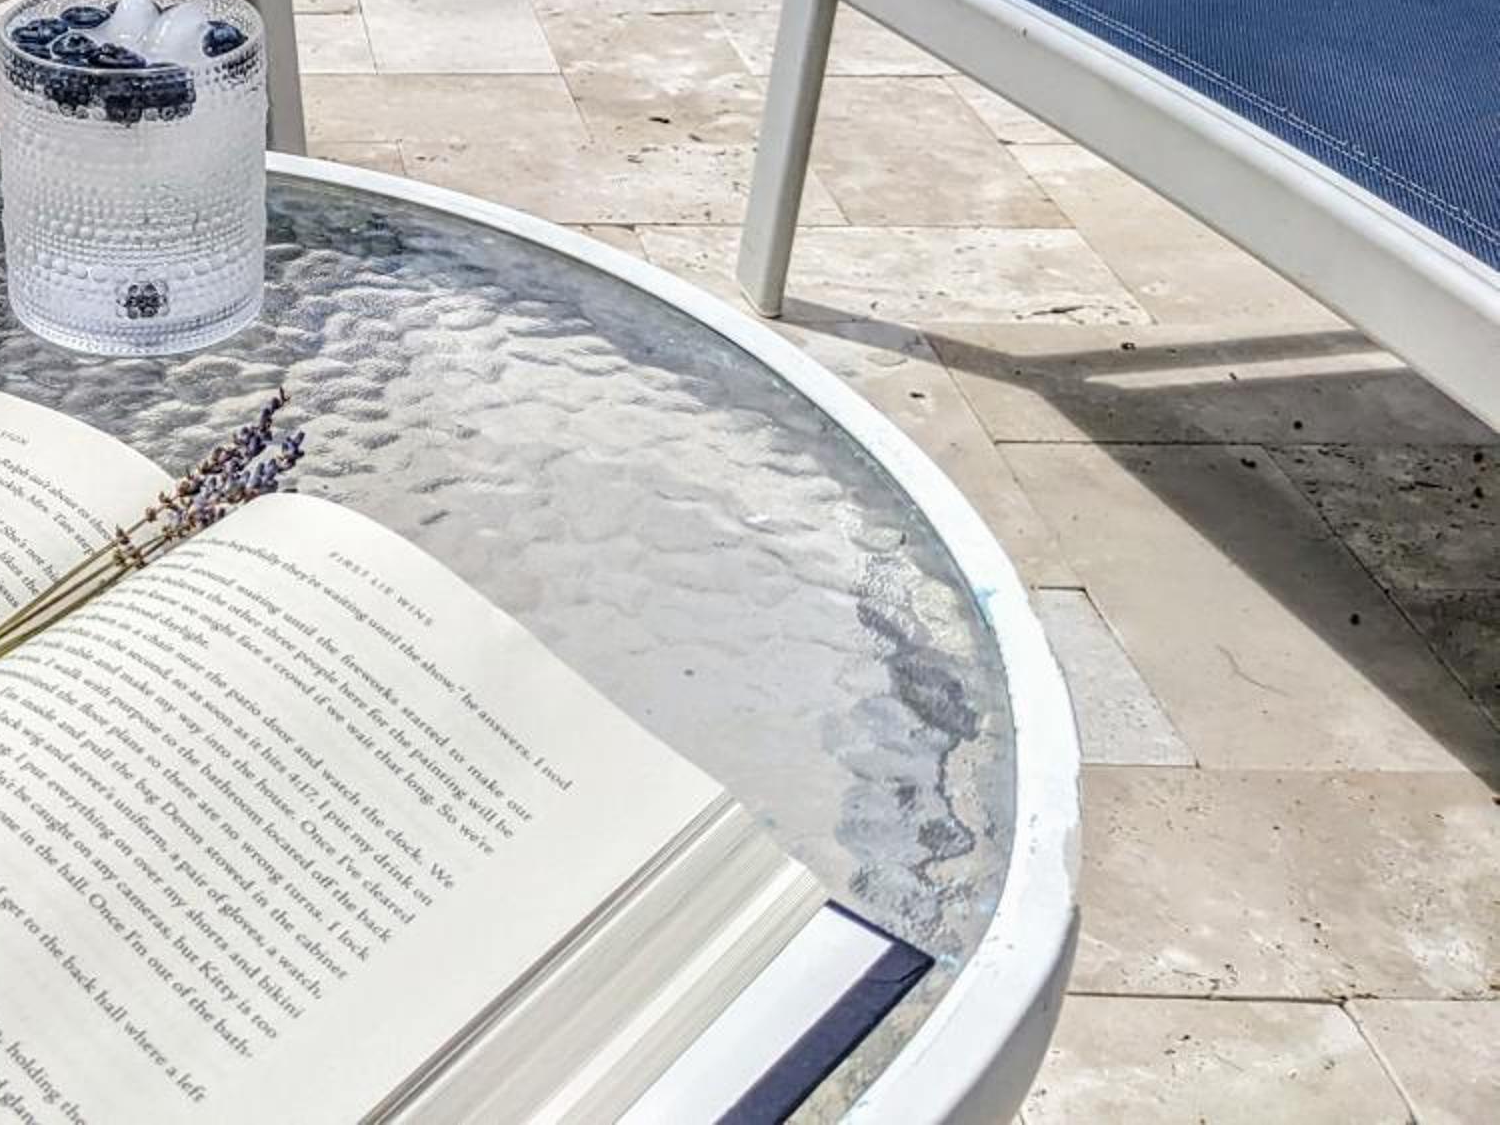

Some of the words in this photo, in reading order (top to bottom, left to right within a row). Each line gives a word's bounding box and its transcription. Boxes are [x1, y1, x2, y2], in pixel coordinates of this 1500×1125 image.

[328, 552, 369, 577] FIRST
[370, 578, 394, 595] LIE
[397, 595, 433, 627] WINS
[224, 689, 261, 716] patio
[262, 717, 295, 744] door
[294, 746, 324, 769] and
[322, 769, 360, 804] watch
[361, 806, 384, 827] the
[431, 863, 454, 888] We
[273, 663, 316, 695] crowd
[347, 723, 375, 749] wait
[374, 750, 404, 775] that
[436, 803, 457, 824] So
[459, 824, 494, 854] we're
[293, 651, 338, 684] people
[338, 682, 368, 709] here
[408, 749, 467, 801] painting
[468, 798, 498, 822] will
[340, 655, 399, 705] fireworks
[401, 707, 450, 747] started
[468, 766, 504, 797] make
[507, 800, 532, 821] our
[368, 619, 402, 645] until
[542, 766, 573, 791] nod
[135, 778, 161, 805] bag
[160, 801, 203, 845] Devon
[204, 847, 256, 891] stowed
[295, 934, 348, 979] cabinet
[162, 769, 197, 799] there
[241, 842, 284, 885] wrong
[337, 930, 369, 962] lock
[175, 861, 208, 887] pair
[177, 747, 200, 766] the
[200, 763, 263, 825] bathroom
[262, 823, 315, 870] located
[311, 871, 338, 889] off
[332, 889, 356, 911] the
[356, 908, 391, 943] back
[203, 733, 231, 759] into
[300, 820, 336, 856] Once
[336, 855, 362, 879] I've
[362, 880, 416, 924] cleared
[260, 747, 287, 773] hits
[323, 811, 352, 833] put
[350, 832, 374, 854] my
[373, 854, 413, 889] drink
[30, 803, 75, 841] caught
[91, 858, 118, 880] any
[173, 936, 199, 963] but
[198, 961, 238, 1001] Kitty
[251, 1015, 277, 1038] too
[89, 894, 125, 932] Once
[123, 930, 147, 957] I'm
[148, 957, 173, 982] out
[188, 998, 214, 1022] the
[134, 857, 164, 884] over
[163, 886, 188, 907] my
[185, 910, 228, 951] shorts
[229, 953, 261, 979] and
[258, 975, 305, 1019] bikini
[6, 1041, 61, 1104] holding
[62, 955, 97, 994] back
[94, 990, 128, 1022] hall
[124, 1021, 167, 1065] where
[176, 1073, 206, 1102] left
